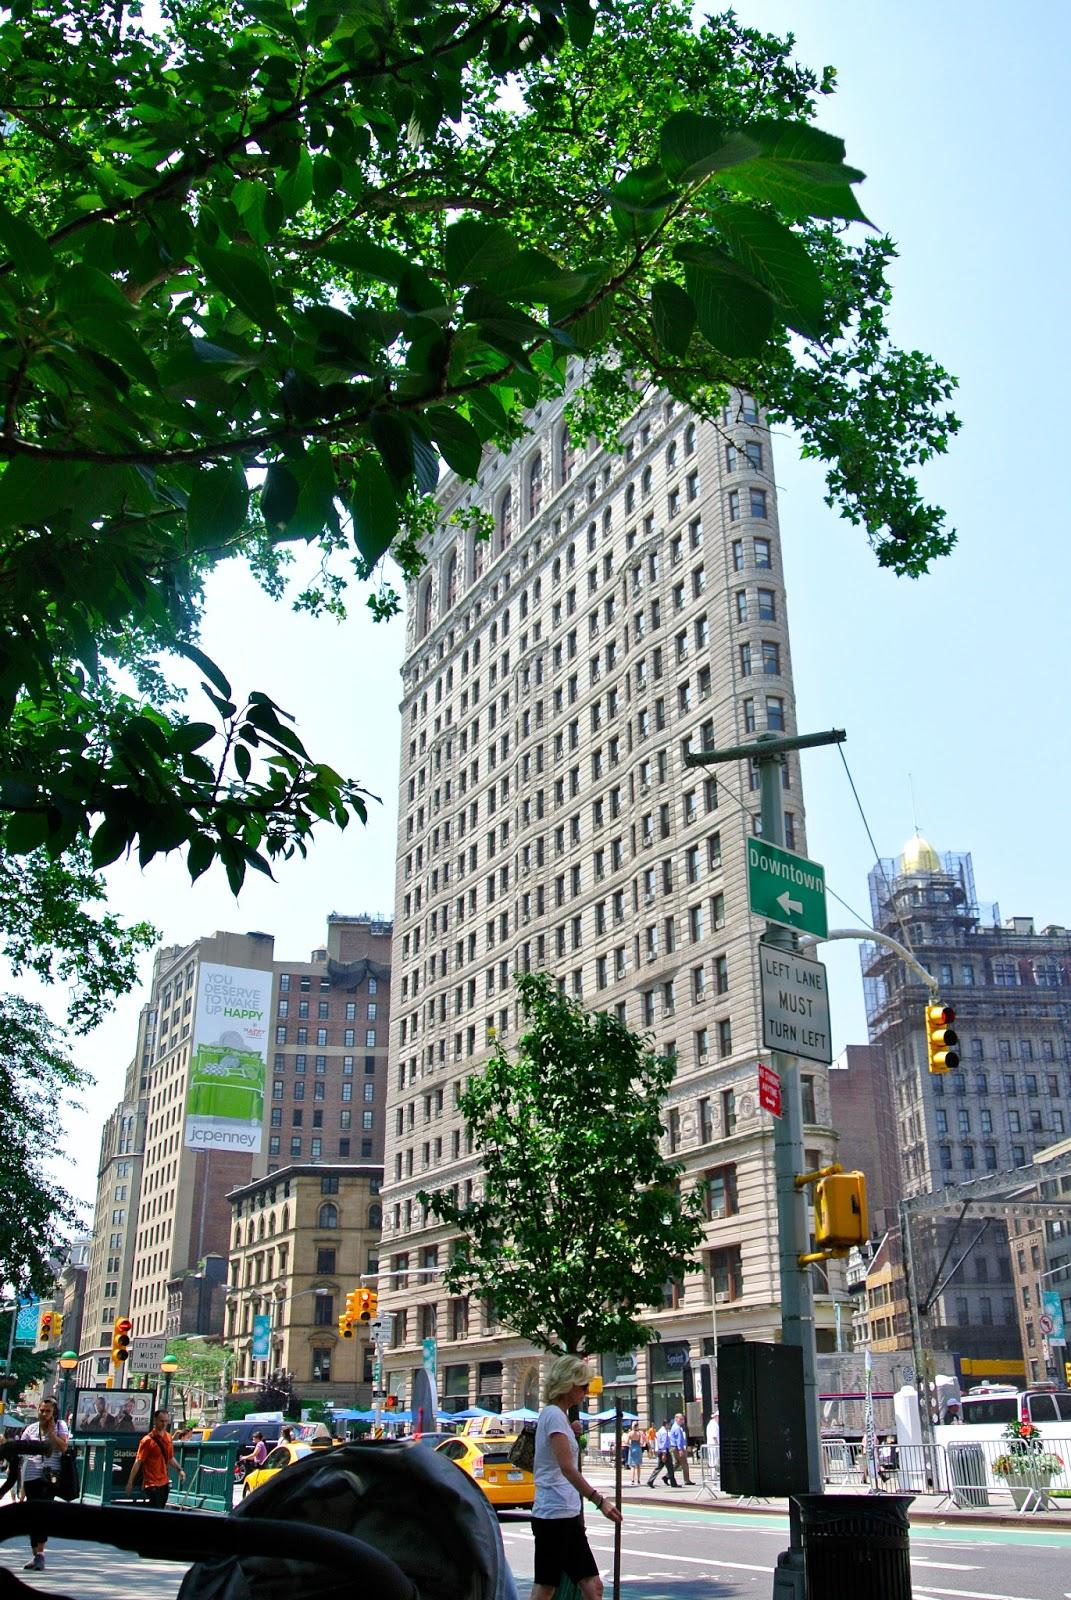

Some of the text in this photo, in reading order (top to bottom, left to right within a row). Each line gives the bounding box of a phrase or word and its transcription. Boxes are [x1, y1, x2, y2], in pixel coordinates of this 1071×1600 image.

[750, 848, 823, 893] Downtown
[207, 974, 233, 985] YOU
[765, 958, 822, 990] LEFT LANE
[204, 983, 261, 1000] DESERVE
[204, 993, 261, 1010] TO WAKE
[779, 990, 813, 1018] MUST
[206, 1005, 264, 1021] UP HAPPY
[769, 1019, 826, 1050] TURN LEFT
[189, 1126, 257, 1147] jcpenney
[140, 1352, 158, 1360] MUST
[617, 1359, 632, 1370] Sprint
[667, 1352, 684, 1366] Sprint
